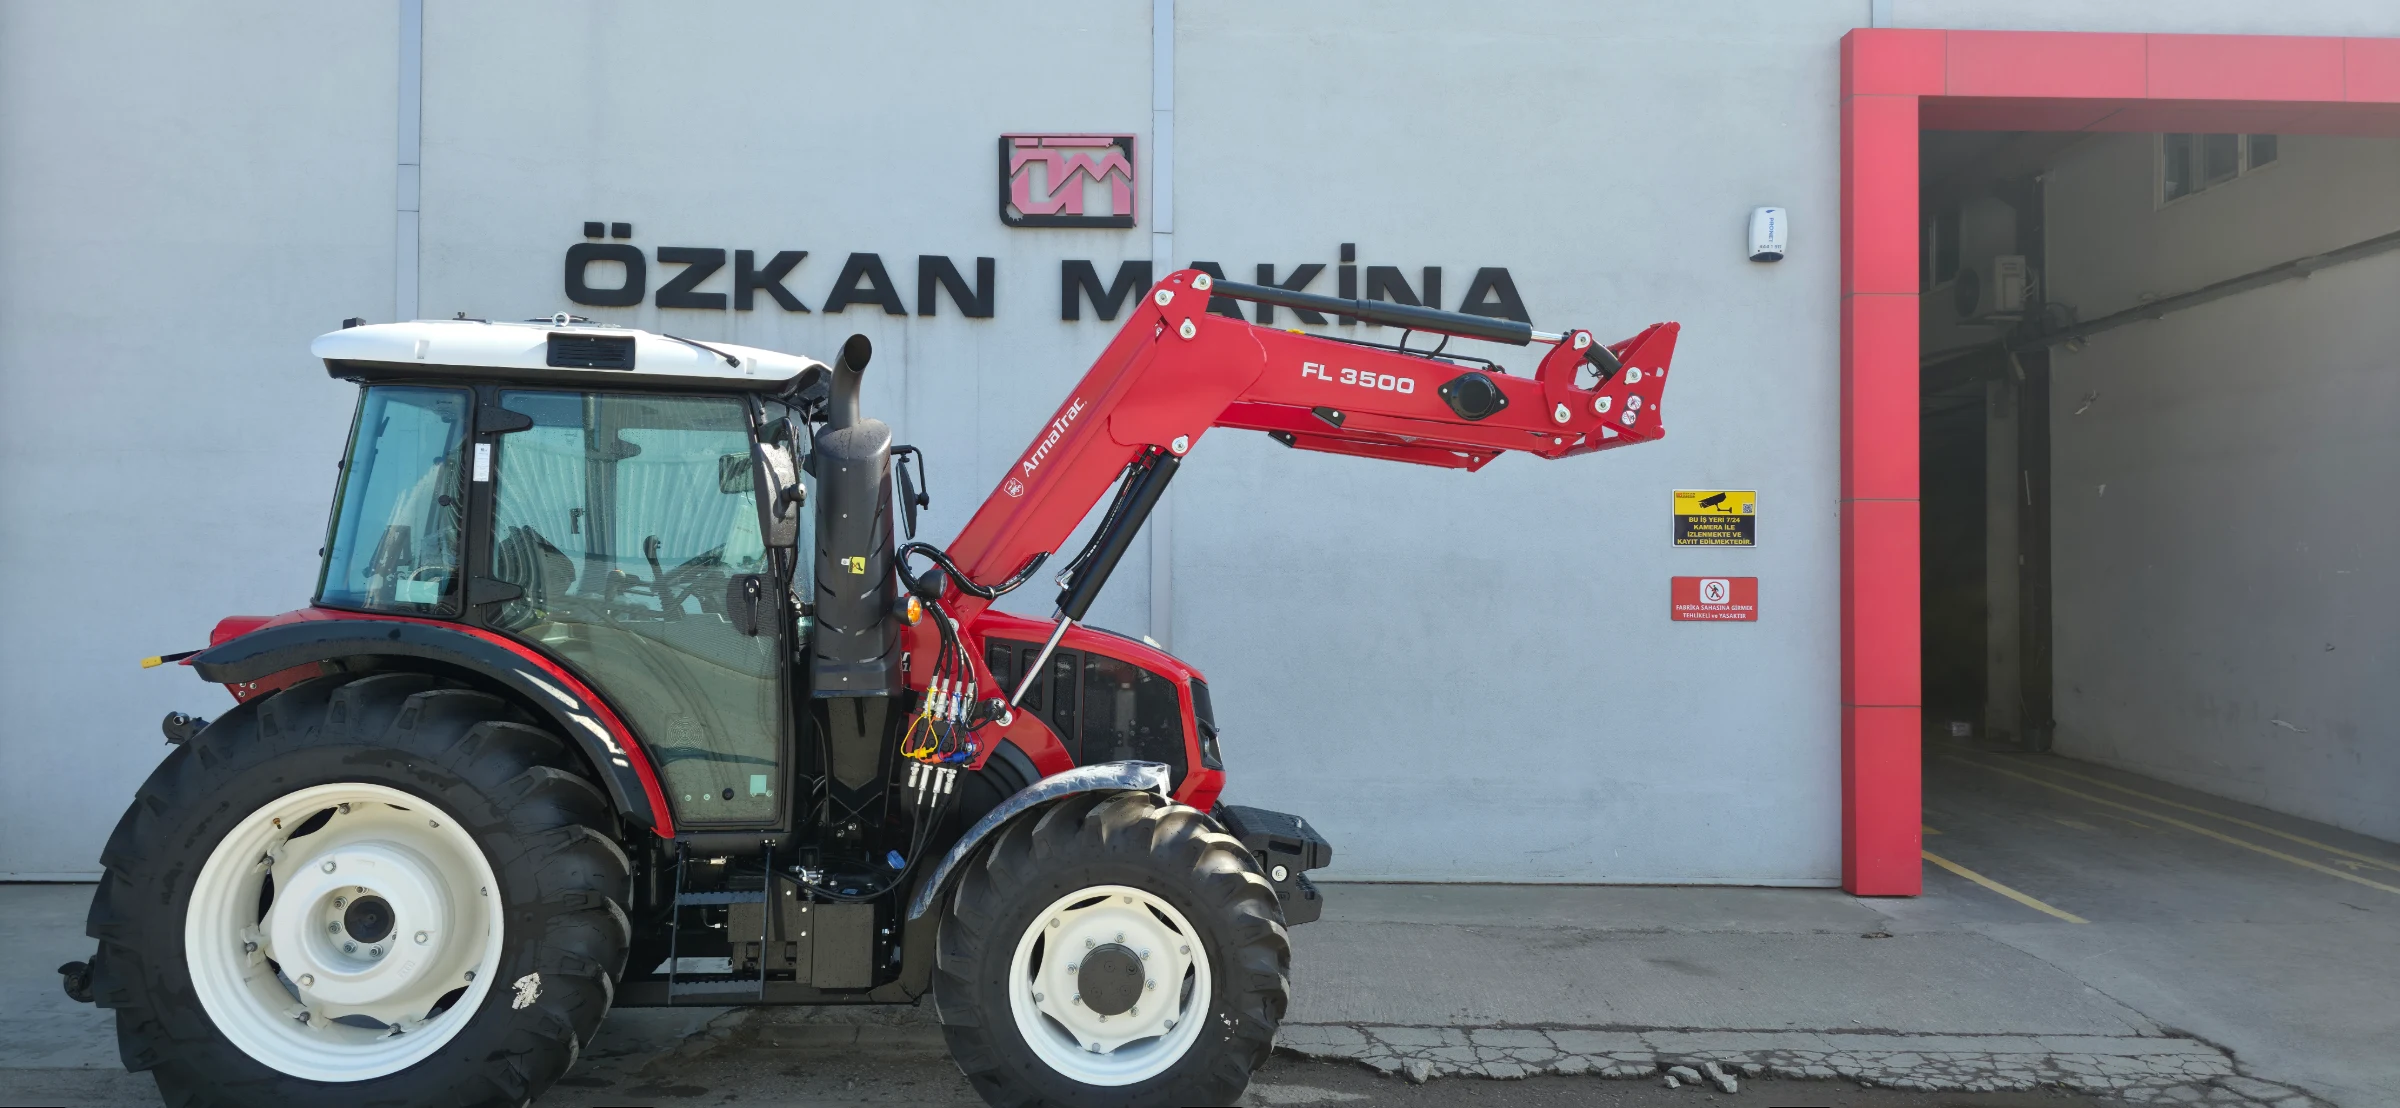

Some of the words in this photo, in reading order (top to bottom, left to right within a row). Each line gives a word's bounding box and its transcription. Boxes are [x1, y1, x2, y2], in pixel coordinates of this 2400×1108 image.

[564, 222, 995, 318] ÖZKAN
[1302, 361, 1333, 381] FL
[1340, 368, 1415, 394] 3500
[1023, 397, 1085, 477] ArmaTrac
